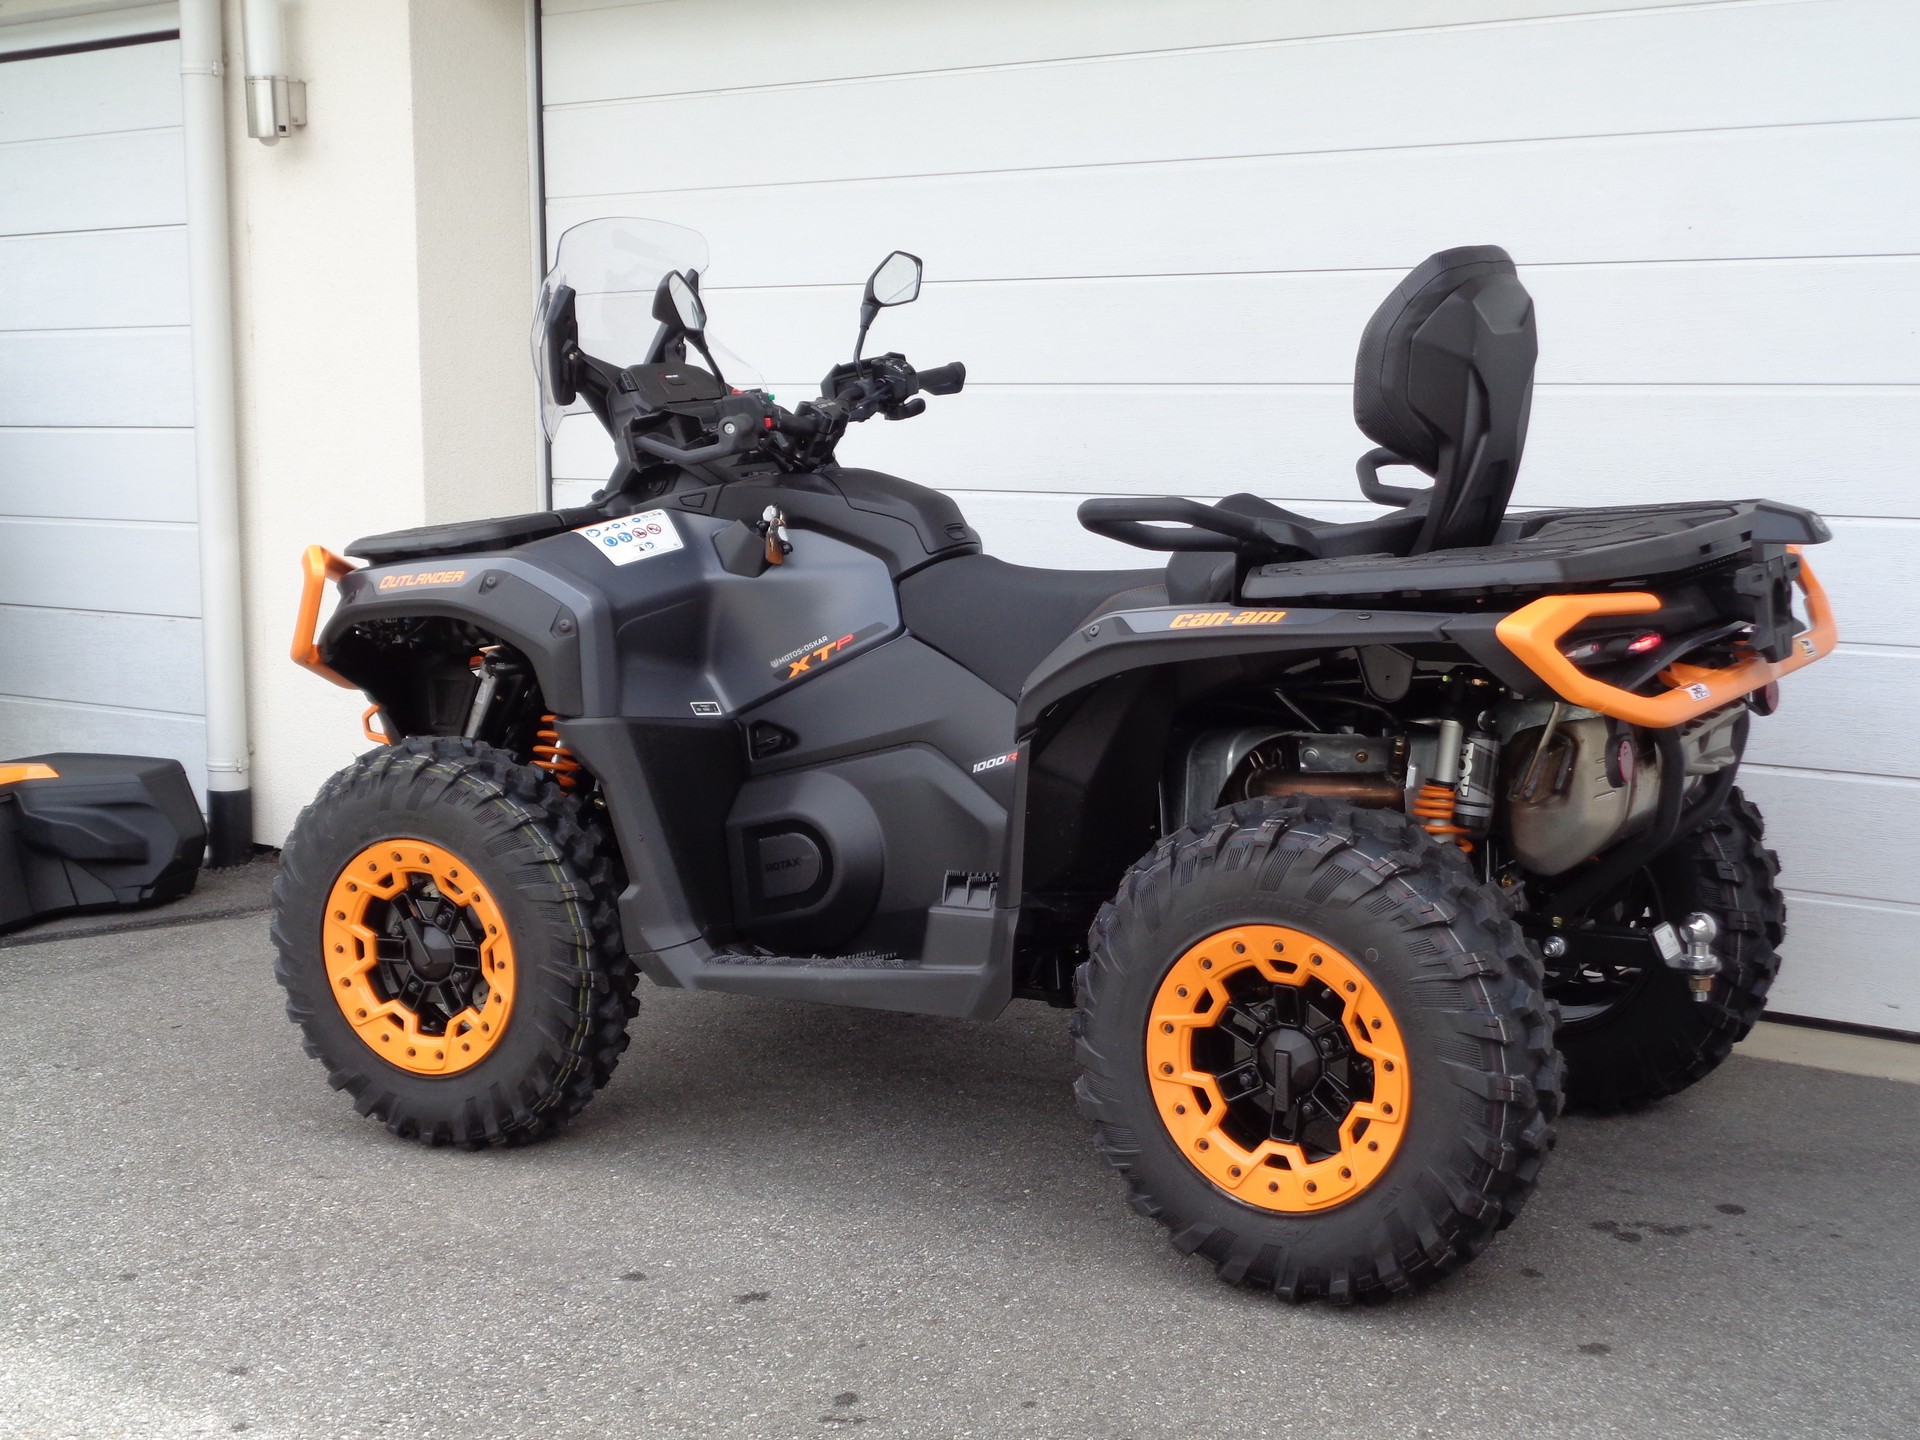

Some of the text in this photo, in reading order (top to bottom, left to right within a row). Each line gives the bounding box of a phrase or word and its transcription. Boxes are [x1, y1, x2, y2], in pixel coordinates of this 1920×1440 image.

[379, 570, 465, 589] OUTLANDER
[1169, 610, 1287, 628] can-am
[779, 635, 829, 665] MOTOS-OSKAR
[1456, 742, 1475, 796] FOX
